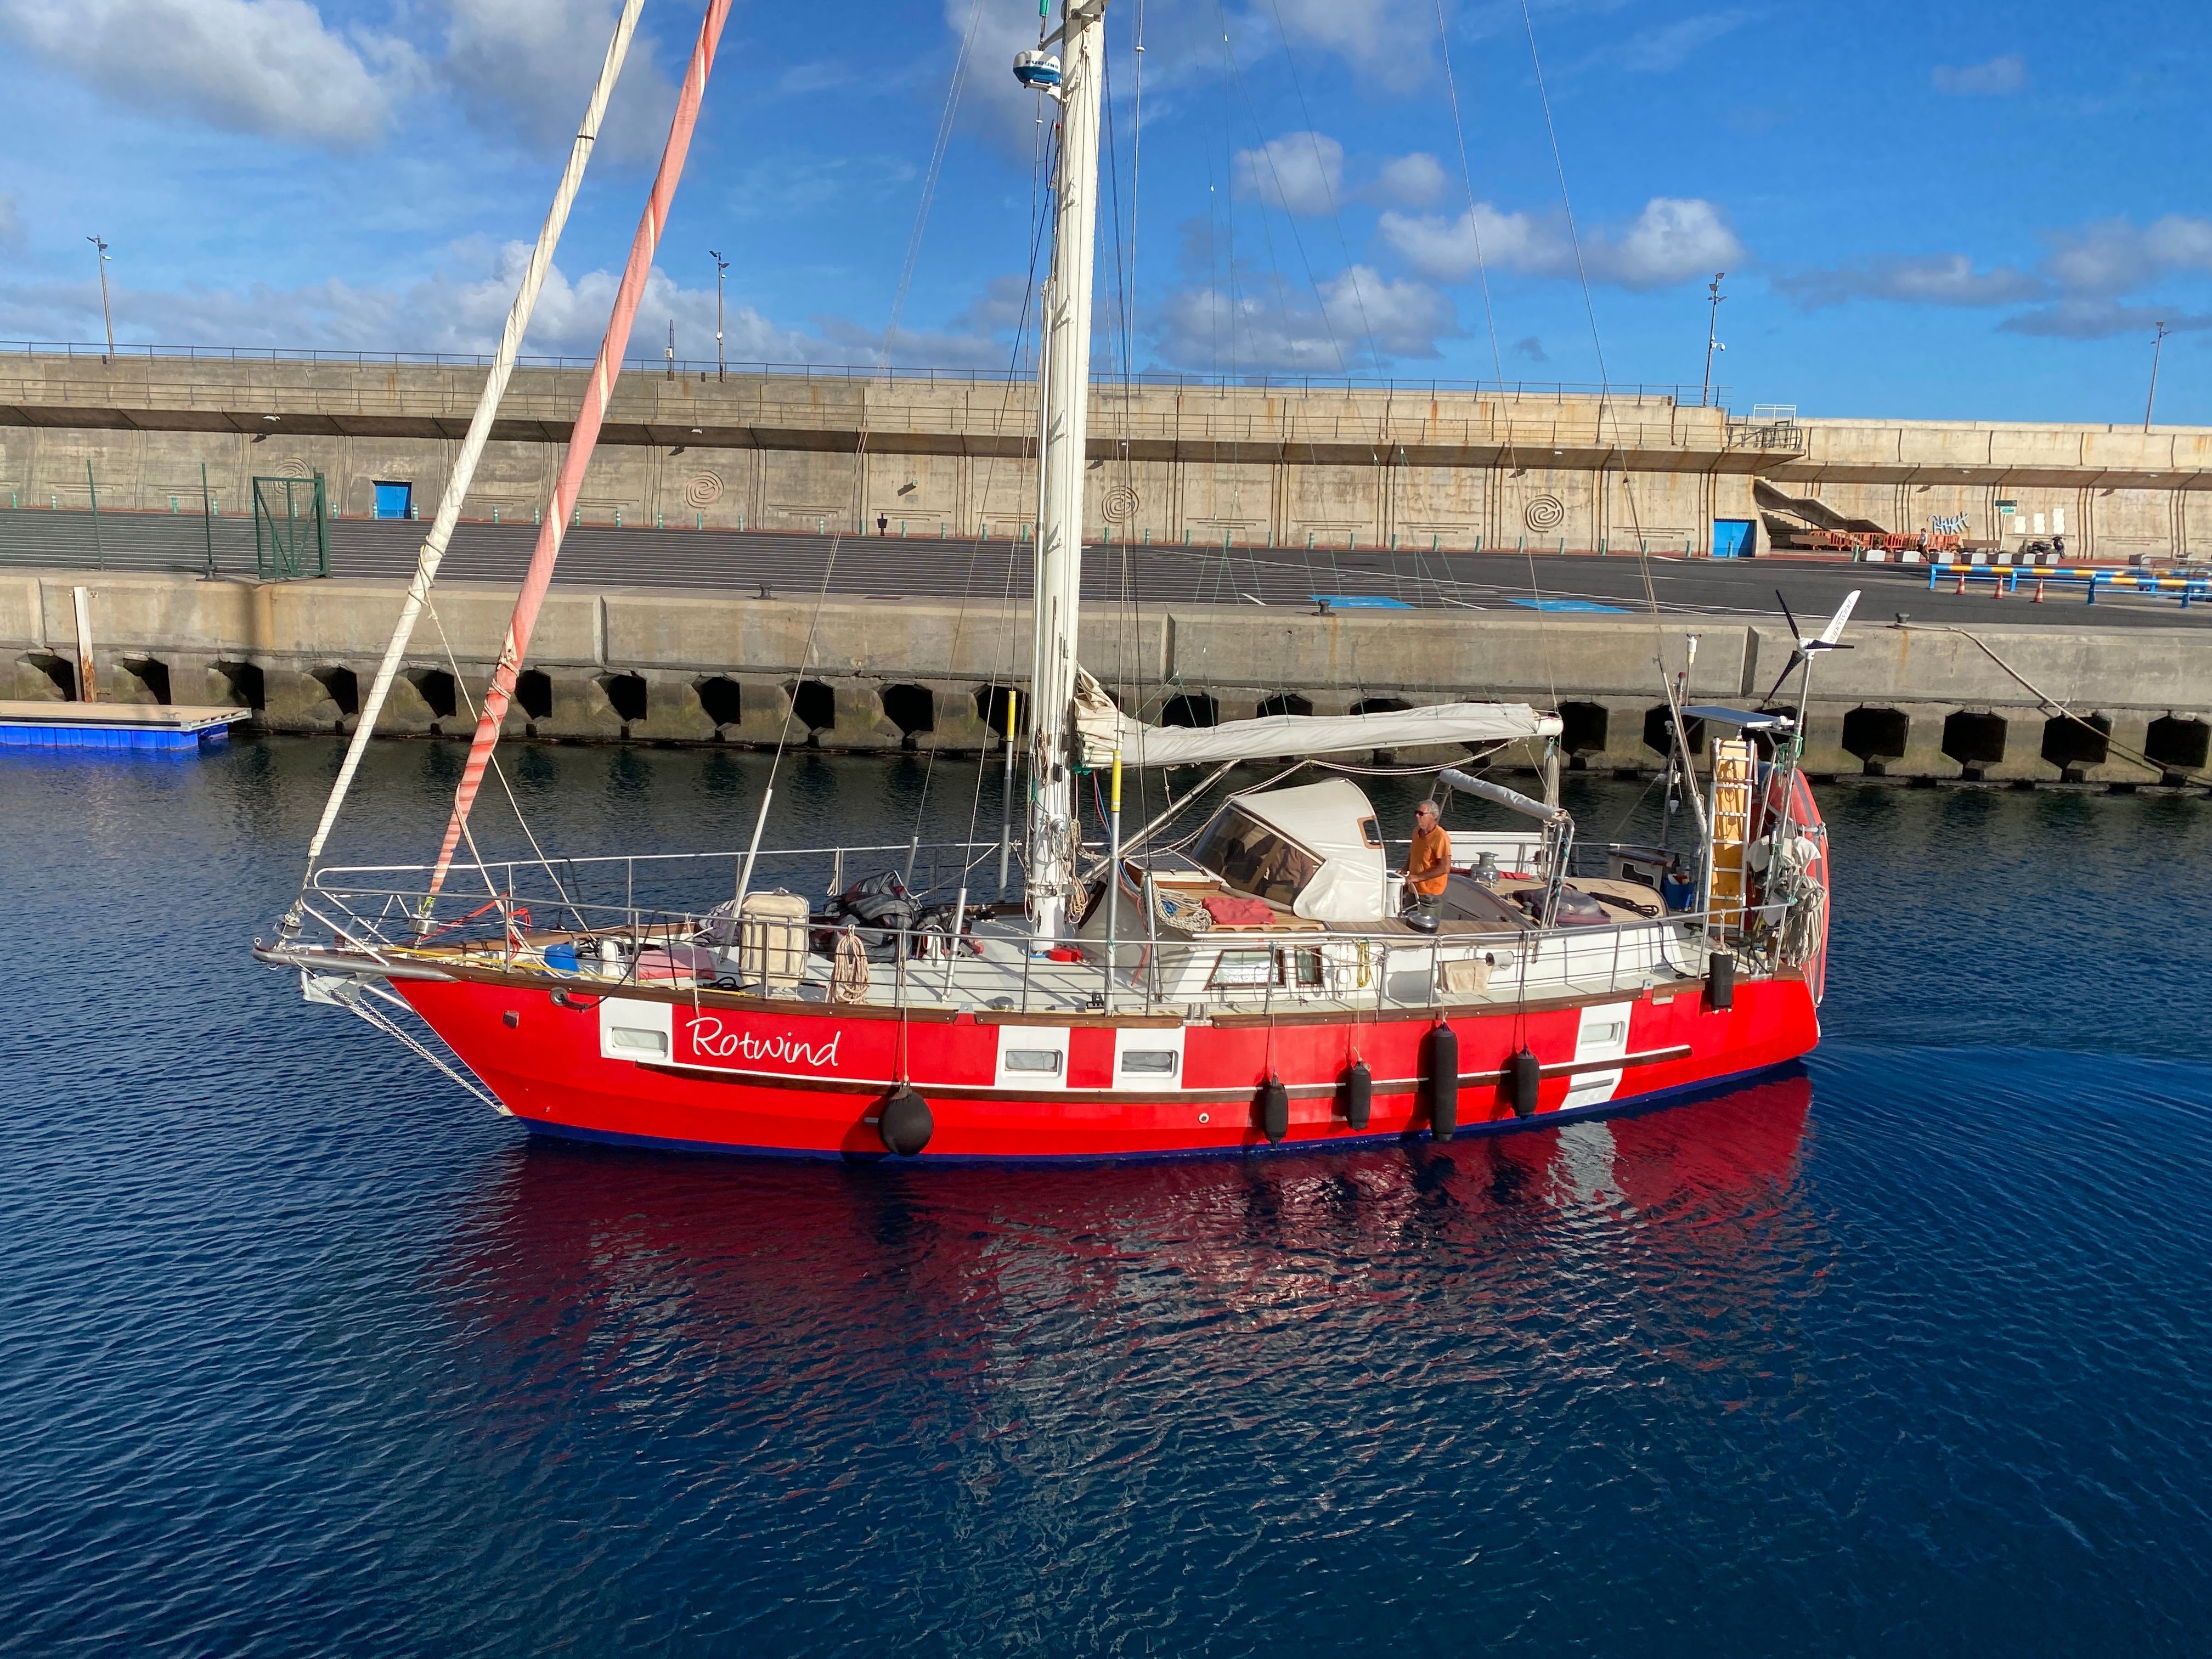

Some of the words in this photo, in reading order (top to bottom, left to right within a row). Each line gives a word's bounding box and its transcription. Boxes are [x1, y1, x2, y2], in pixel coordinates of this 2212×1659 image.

[1025, 60, 1058, 69] FURUNO
[1829, 599, 1852, 642] superwind
[686, 1017, 841, 1066] Rotwind
